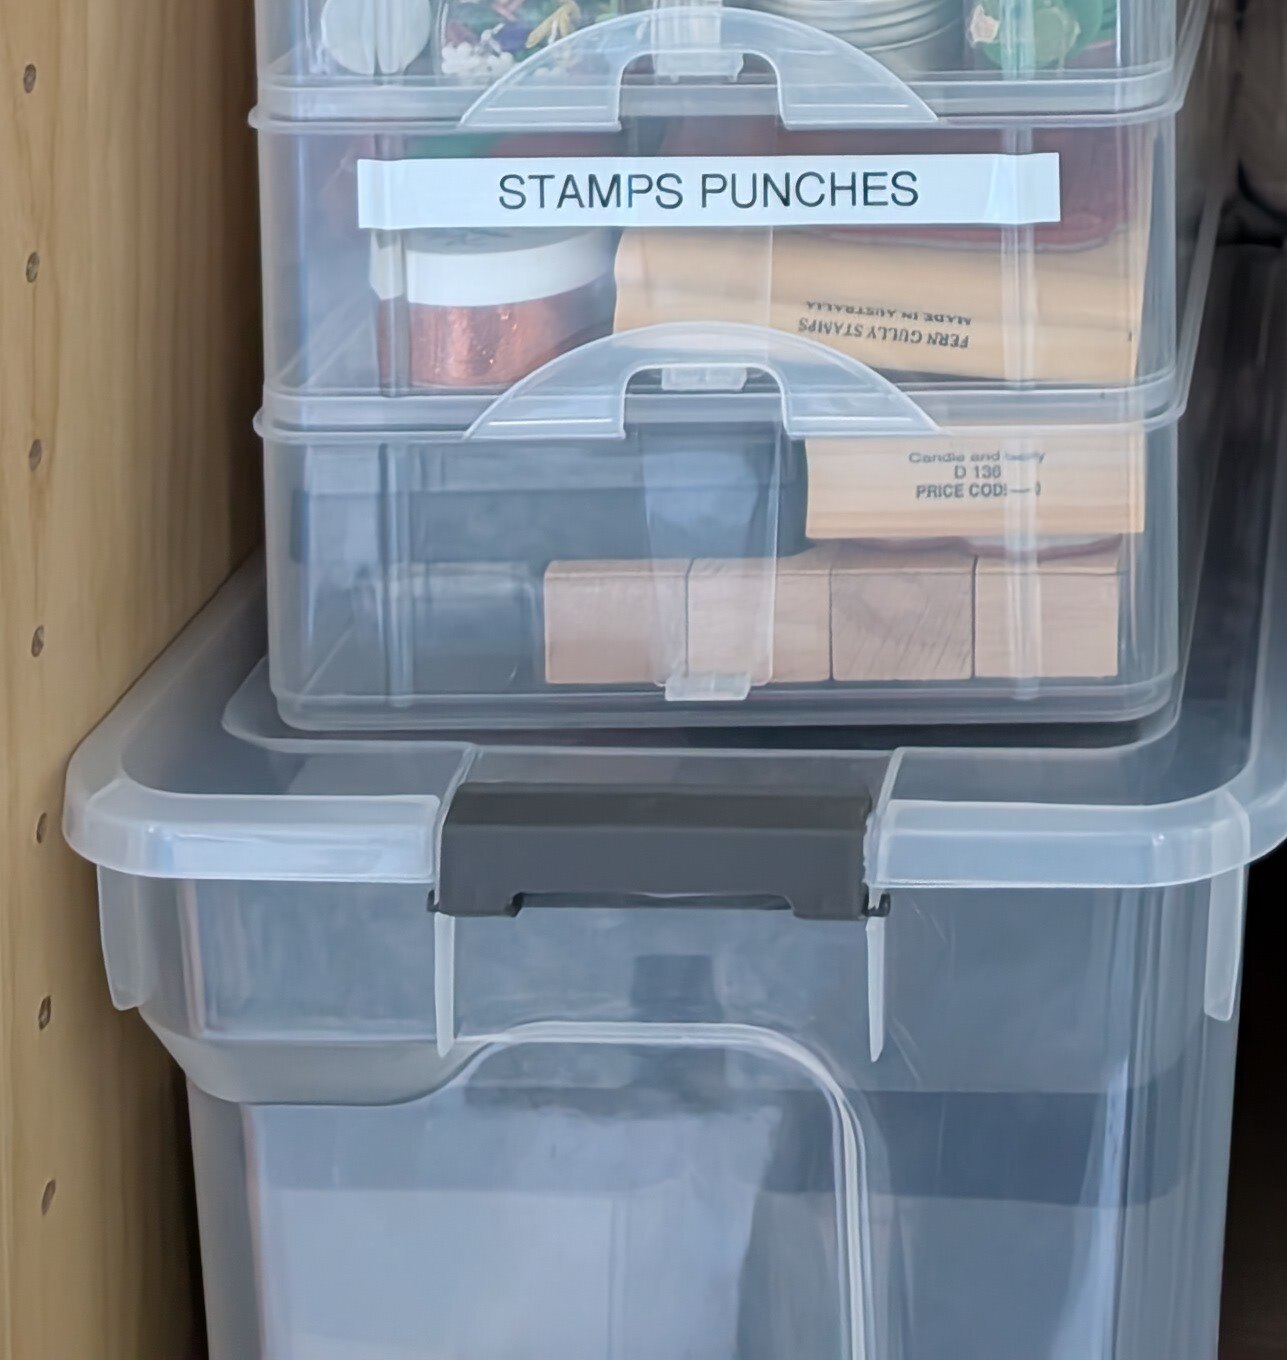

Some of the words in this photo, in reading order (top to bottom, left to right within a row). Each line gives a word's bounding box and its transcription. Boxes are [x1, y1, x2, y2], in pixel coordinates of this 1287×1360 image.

[498, 171, 684, 210] STAMPS
[700, 169, 920, 209] PUNCHES
[806, 301, 898, 318] AUSTRALIA
[901, 310, 919, 322] IN
[798, 316, 864, 337] STAMPS
[924, 312, 972, 326] MADE
[867, 325, 923, 345] GULLY
[926, 333, 970, 349] FERN
[970, 450, 1001, 463] and
[954, 464, 967, 479] D
[915, 482, 965, 499] PRICE
